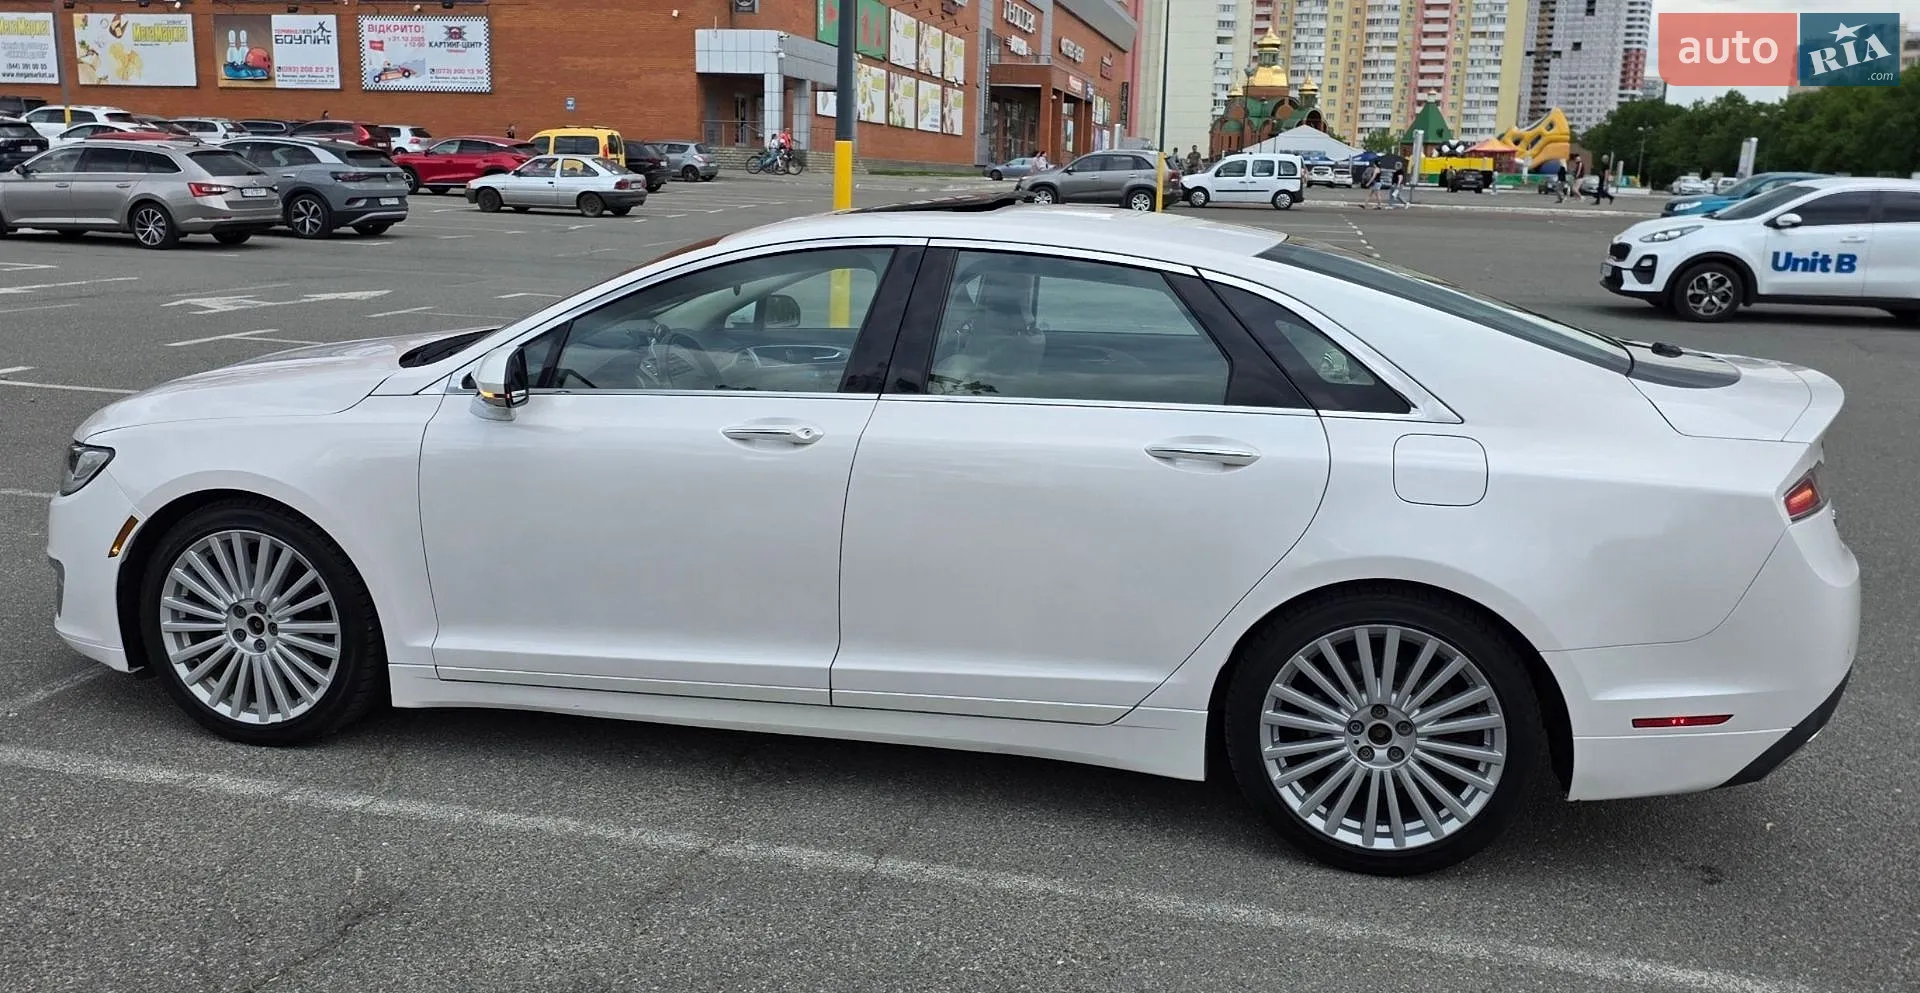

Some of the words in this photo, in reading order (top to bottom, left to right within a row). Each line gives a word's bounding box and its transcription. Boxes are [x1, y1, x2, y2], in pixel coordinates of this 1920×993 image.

[367, 23, 425, 33] ВІДКРИТО!
[274, 34, 332, 45] БОУЛІНГ
[1771, 251, 1833, 273] Unit
[1834, 253, 1858, 274] B
